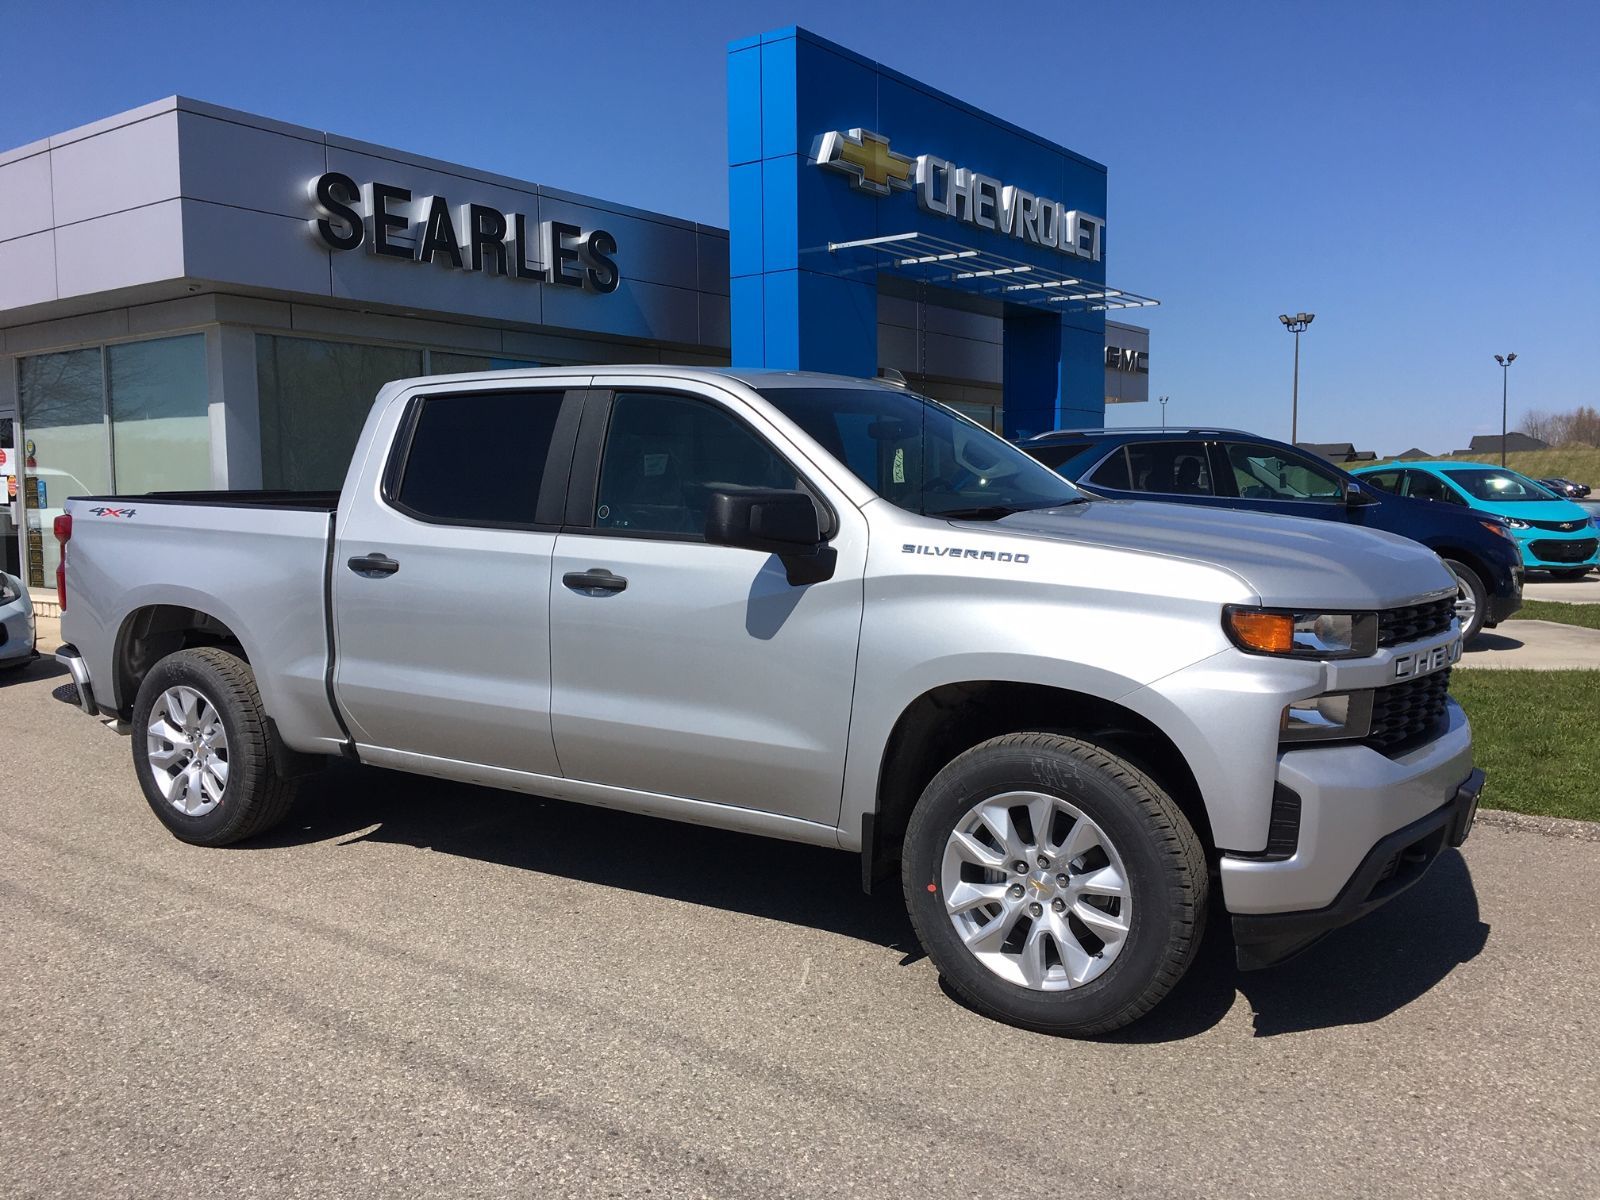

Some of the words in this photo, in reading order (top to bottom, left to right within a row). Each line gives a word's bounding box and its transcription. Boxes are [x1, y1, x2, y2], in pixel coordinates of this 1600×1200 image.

[309, 171, 620, 294] SEARLES
[916, 154, 1105, 262] CHEVROLET
[1104, 346, 1149, 374] GMC
[901, 543, 1030, 564] SILVERADO
